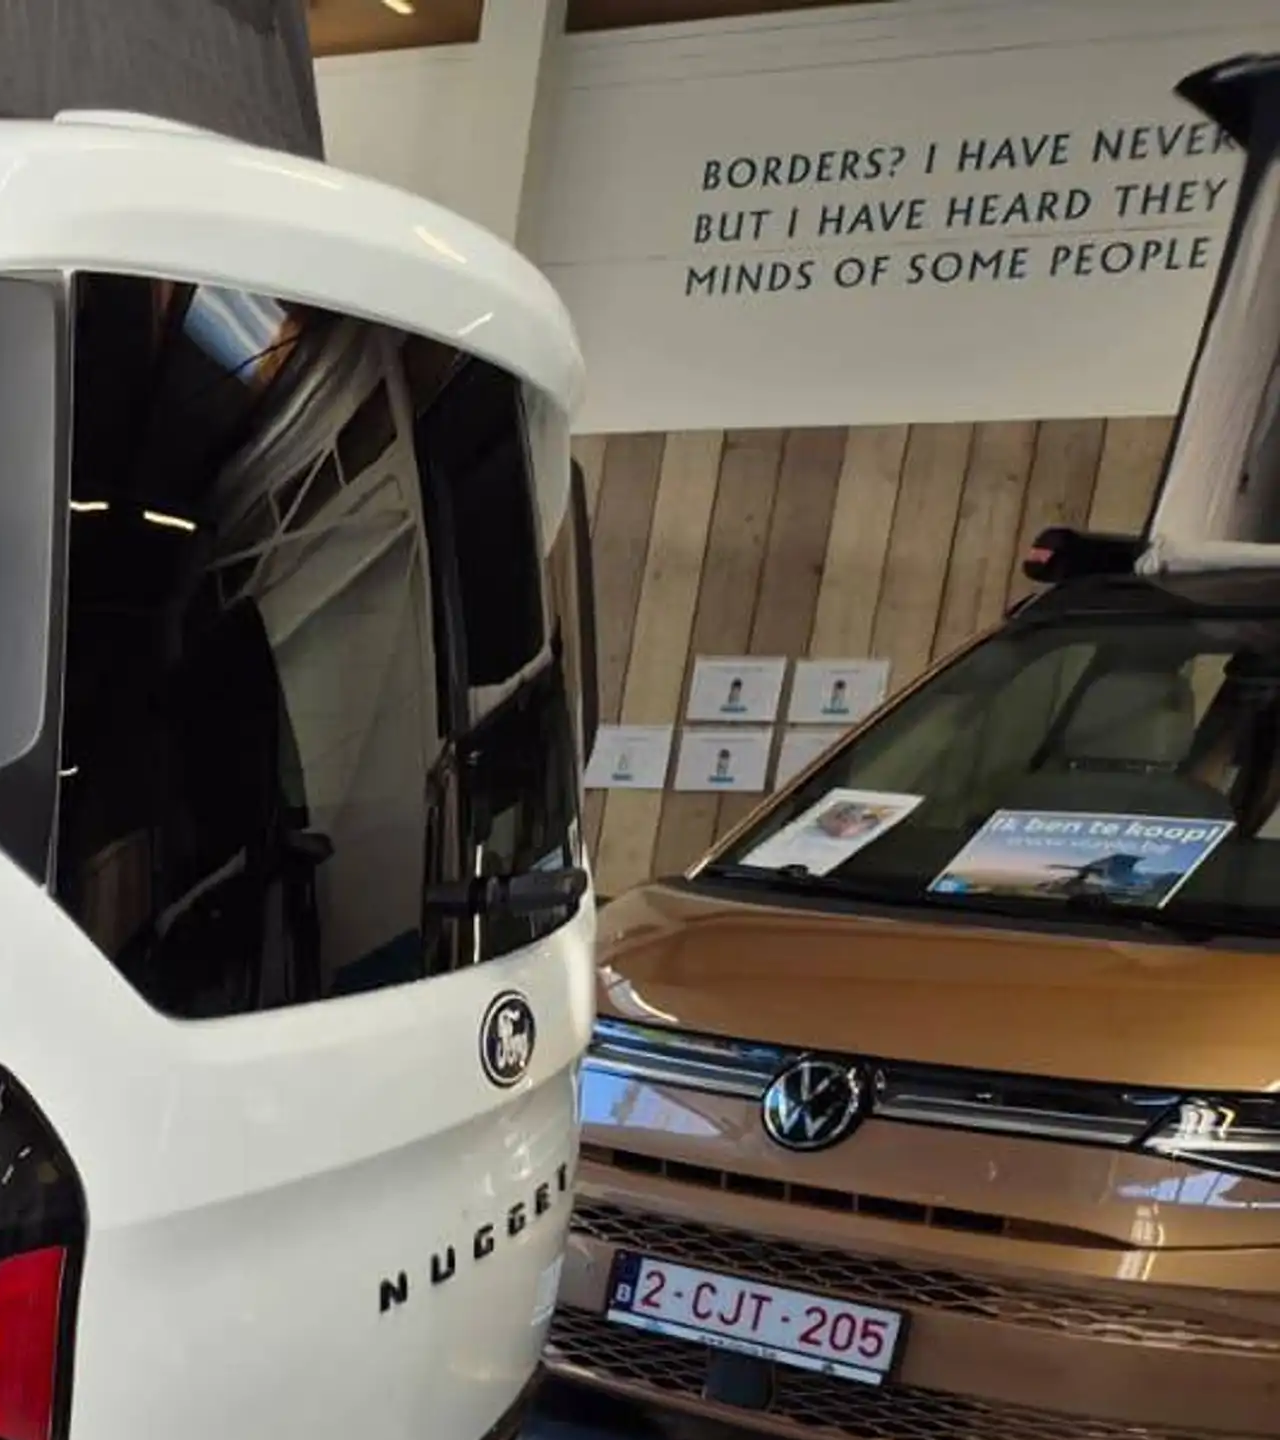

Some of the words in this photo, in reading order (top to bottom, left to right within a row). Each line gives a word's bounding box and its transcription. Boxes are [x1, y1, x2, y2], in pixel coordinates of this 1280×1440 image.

[702, 146, 905, 190] BORDERS?
[924, 142, 937, 174] I
[956, 133, 1070, 172] HAVE
[694, 209, 771, 243] BUT
[787, 206, 798, 238] I
[818, 199, 926, 237] HAVE
[946, 188, 1092, 228] HEARD
[1114, 177, 1228, 218] THEY
[685, 259, 815, 297] MINDS
[835, 255, 890, 288] OF
[906, 247, 1030, 284] SOME
[1049, 236, 1211, 277] PEOPLE
[1024, 817, 1083, 834] ben
[1088, 818, 1120, 835] te
[379, 1162, 568, 1314] NUGGET
